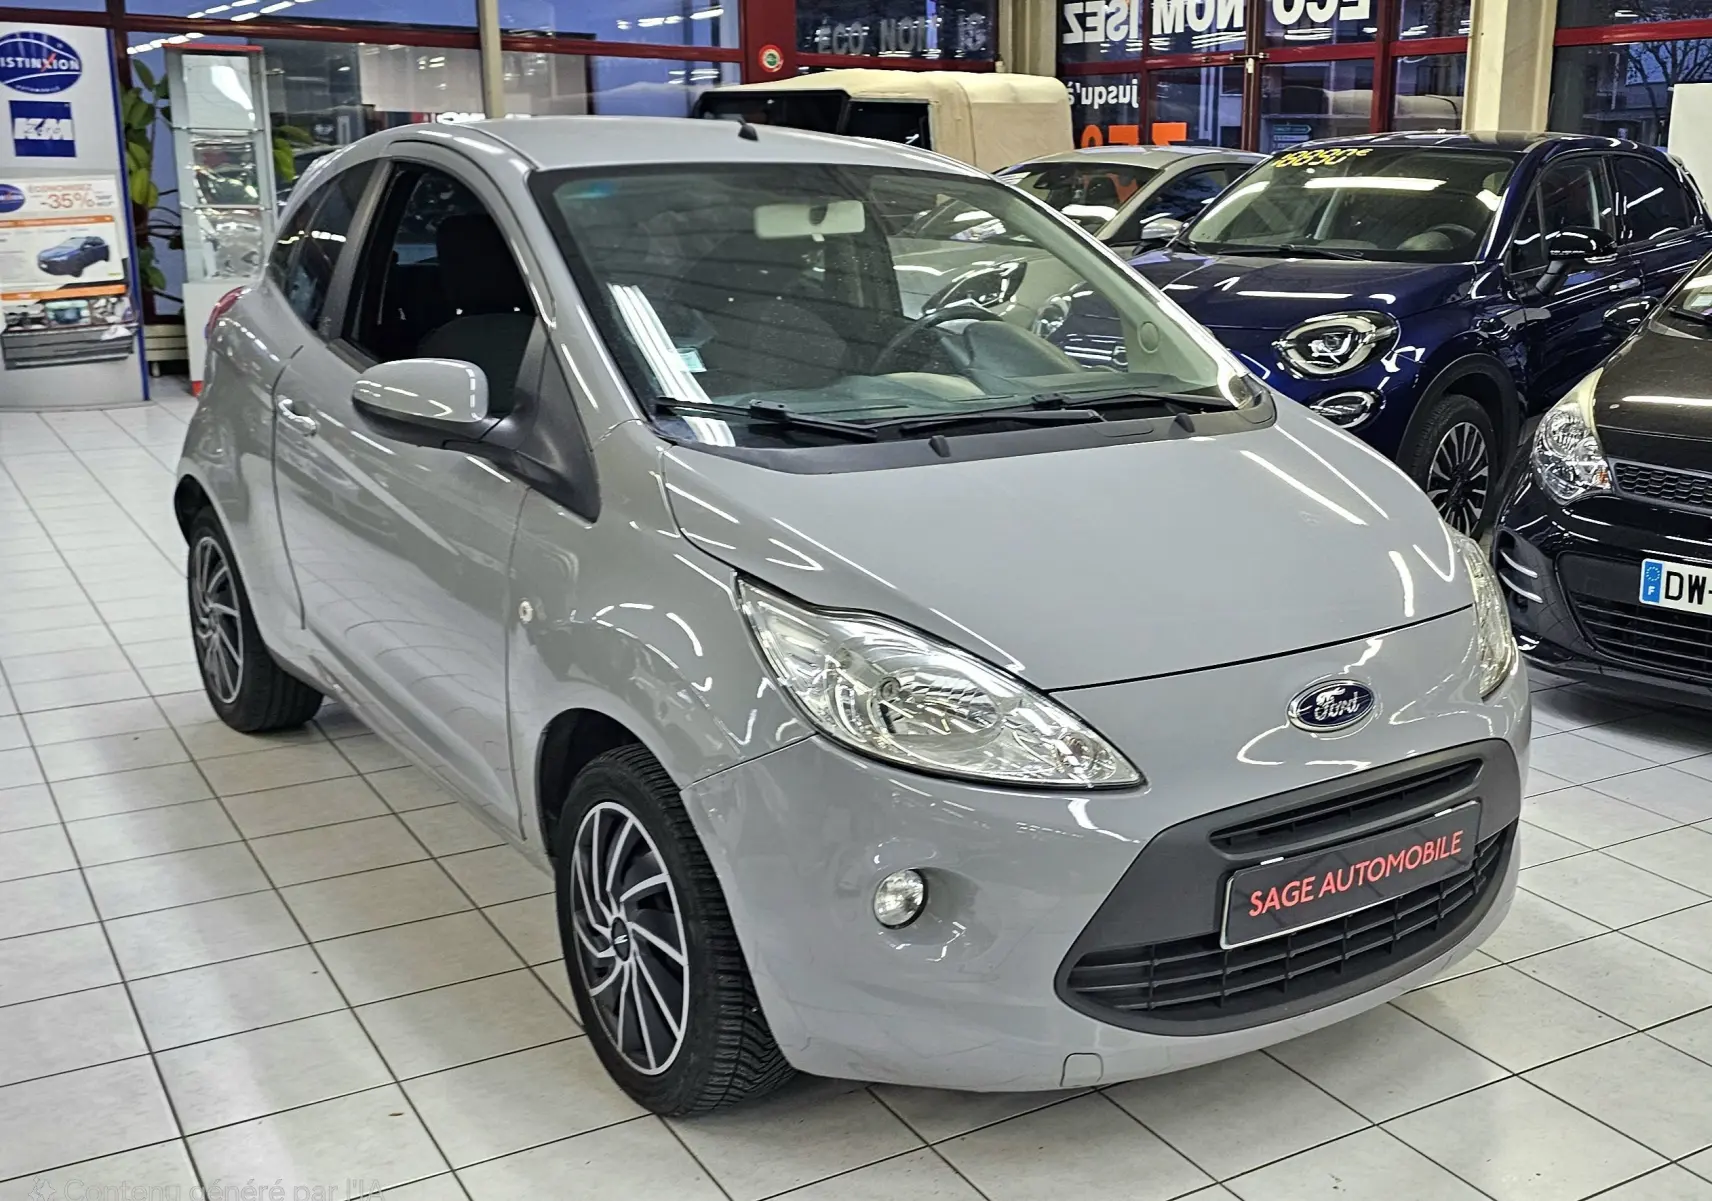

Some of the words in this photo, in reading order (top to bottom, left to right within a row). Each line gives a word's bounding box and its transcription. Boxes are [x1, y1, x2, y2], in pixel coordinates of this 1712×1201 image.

[1314, 687, 1360, 721] Ford
[1249, 876, 1316, 917] SAGE
[1318, 830, 1463, 898] AUTOMOBILE
